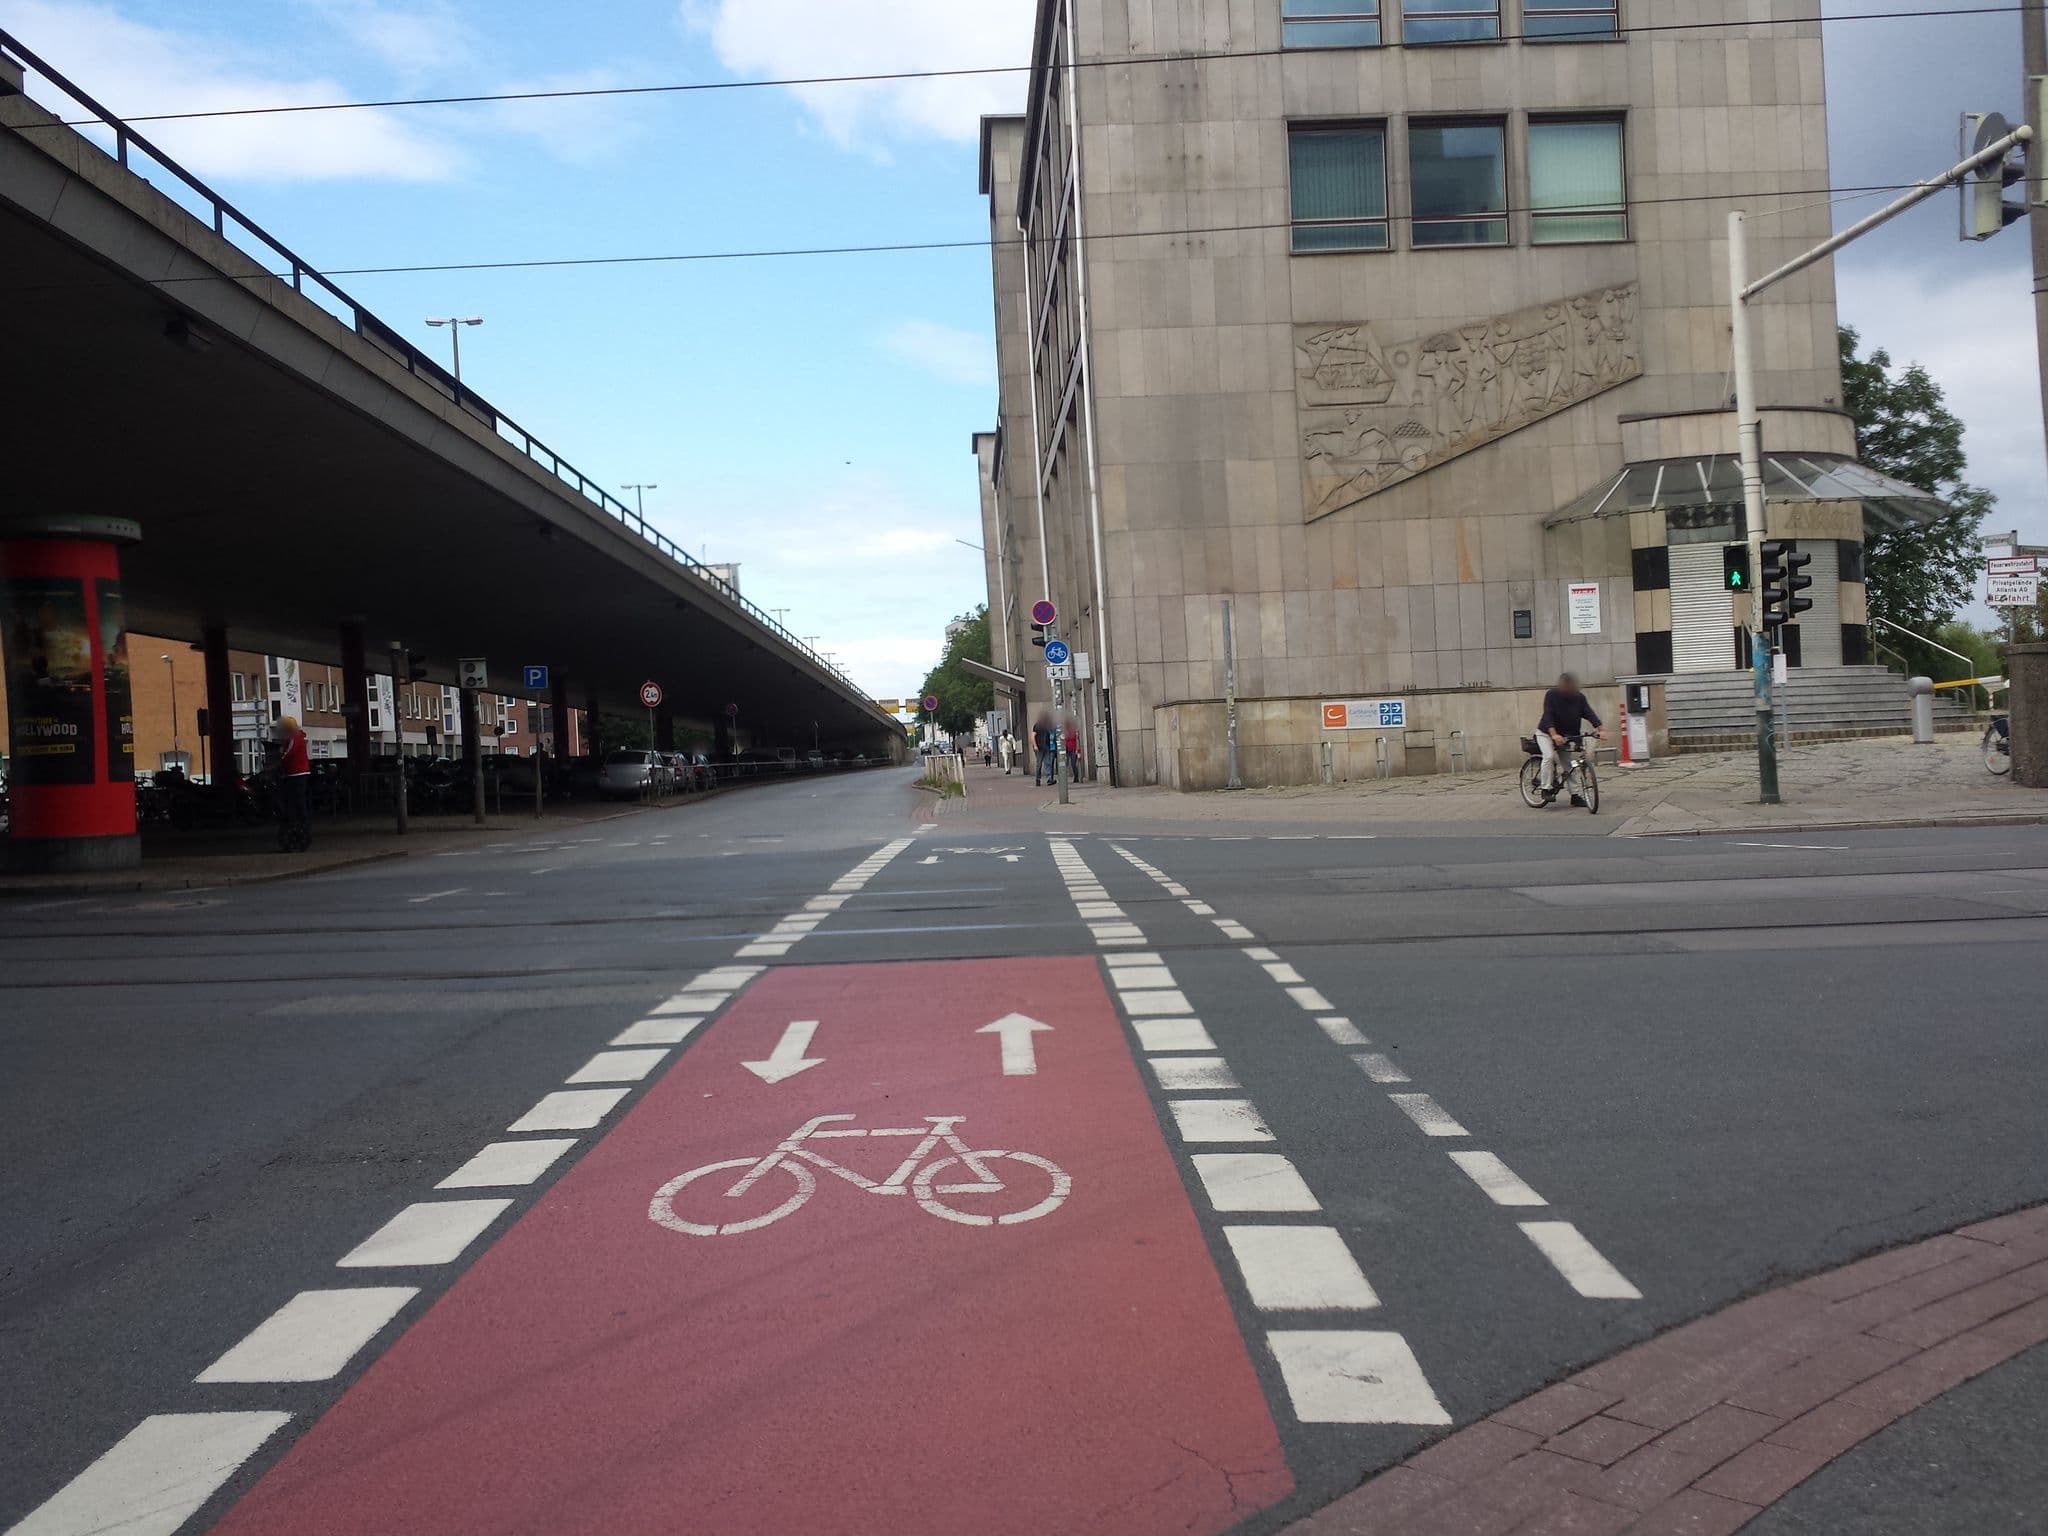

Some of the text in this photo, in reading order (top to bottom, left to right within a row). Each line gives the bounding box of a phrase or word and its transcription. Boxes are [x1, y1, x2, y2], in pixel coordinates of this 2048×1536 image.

[1994, 594, 2030, 602] Efahrt
[529, 669, 542, 686] P
[1382, 716, 1389, 725] P
